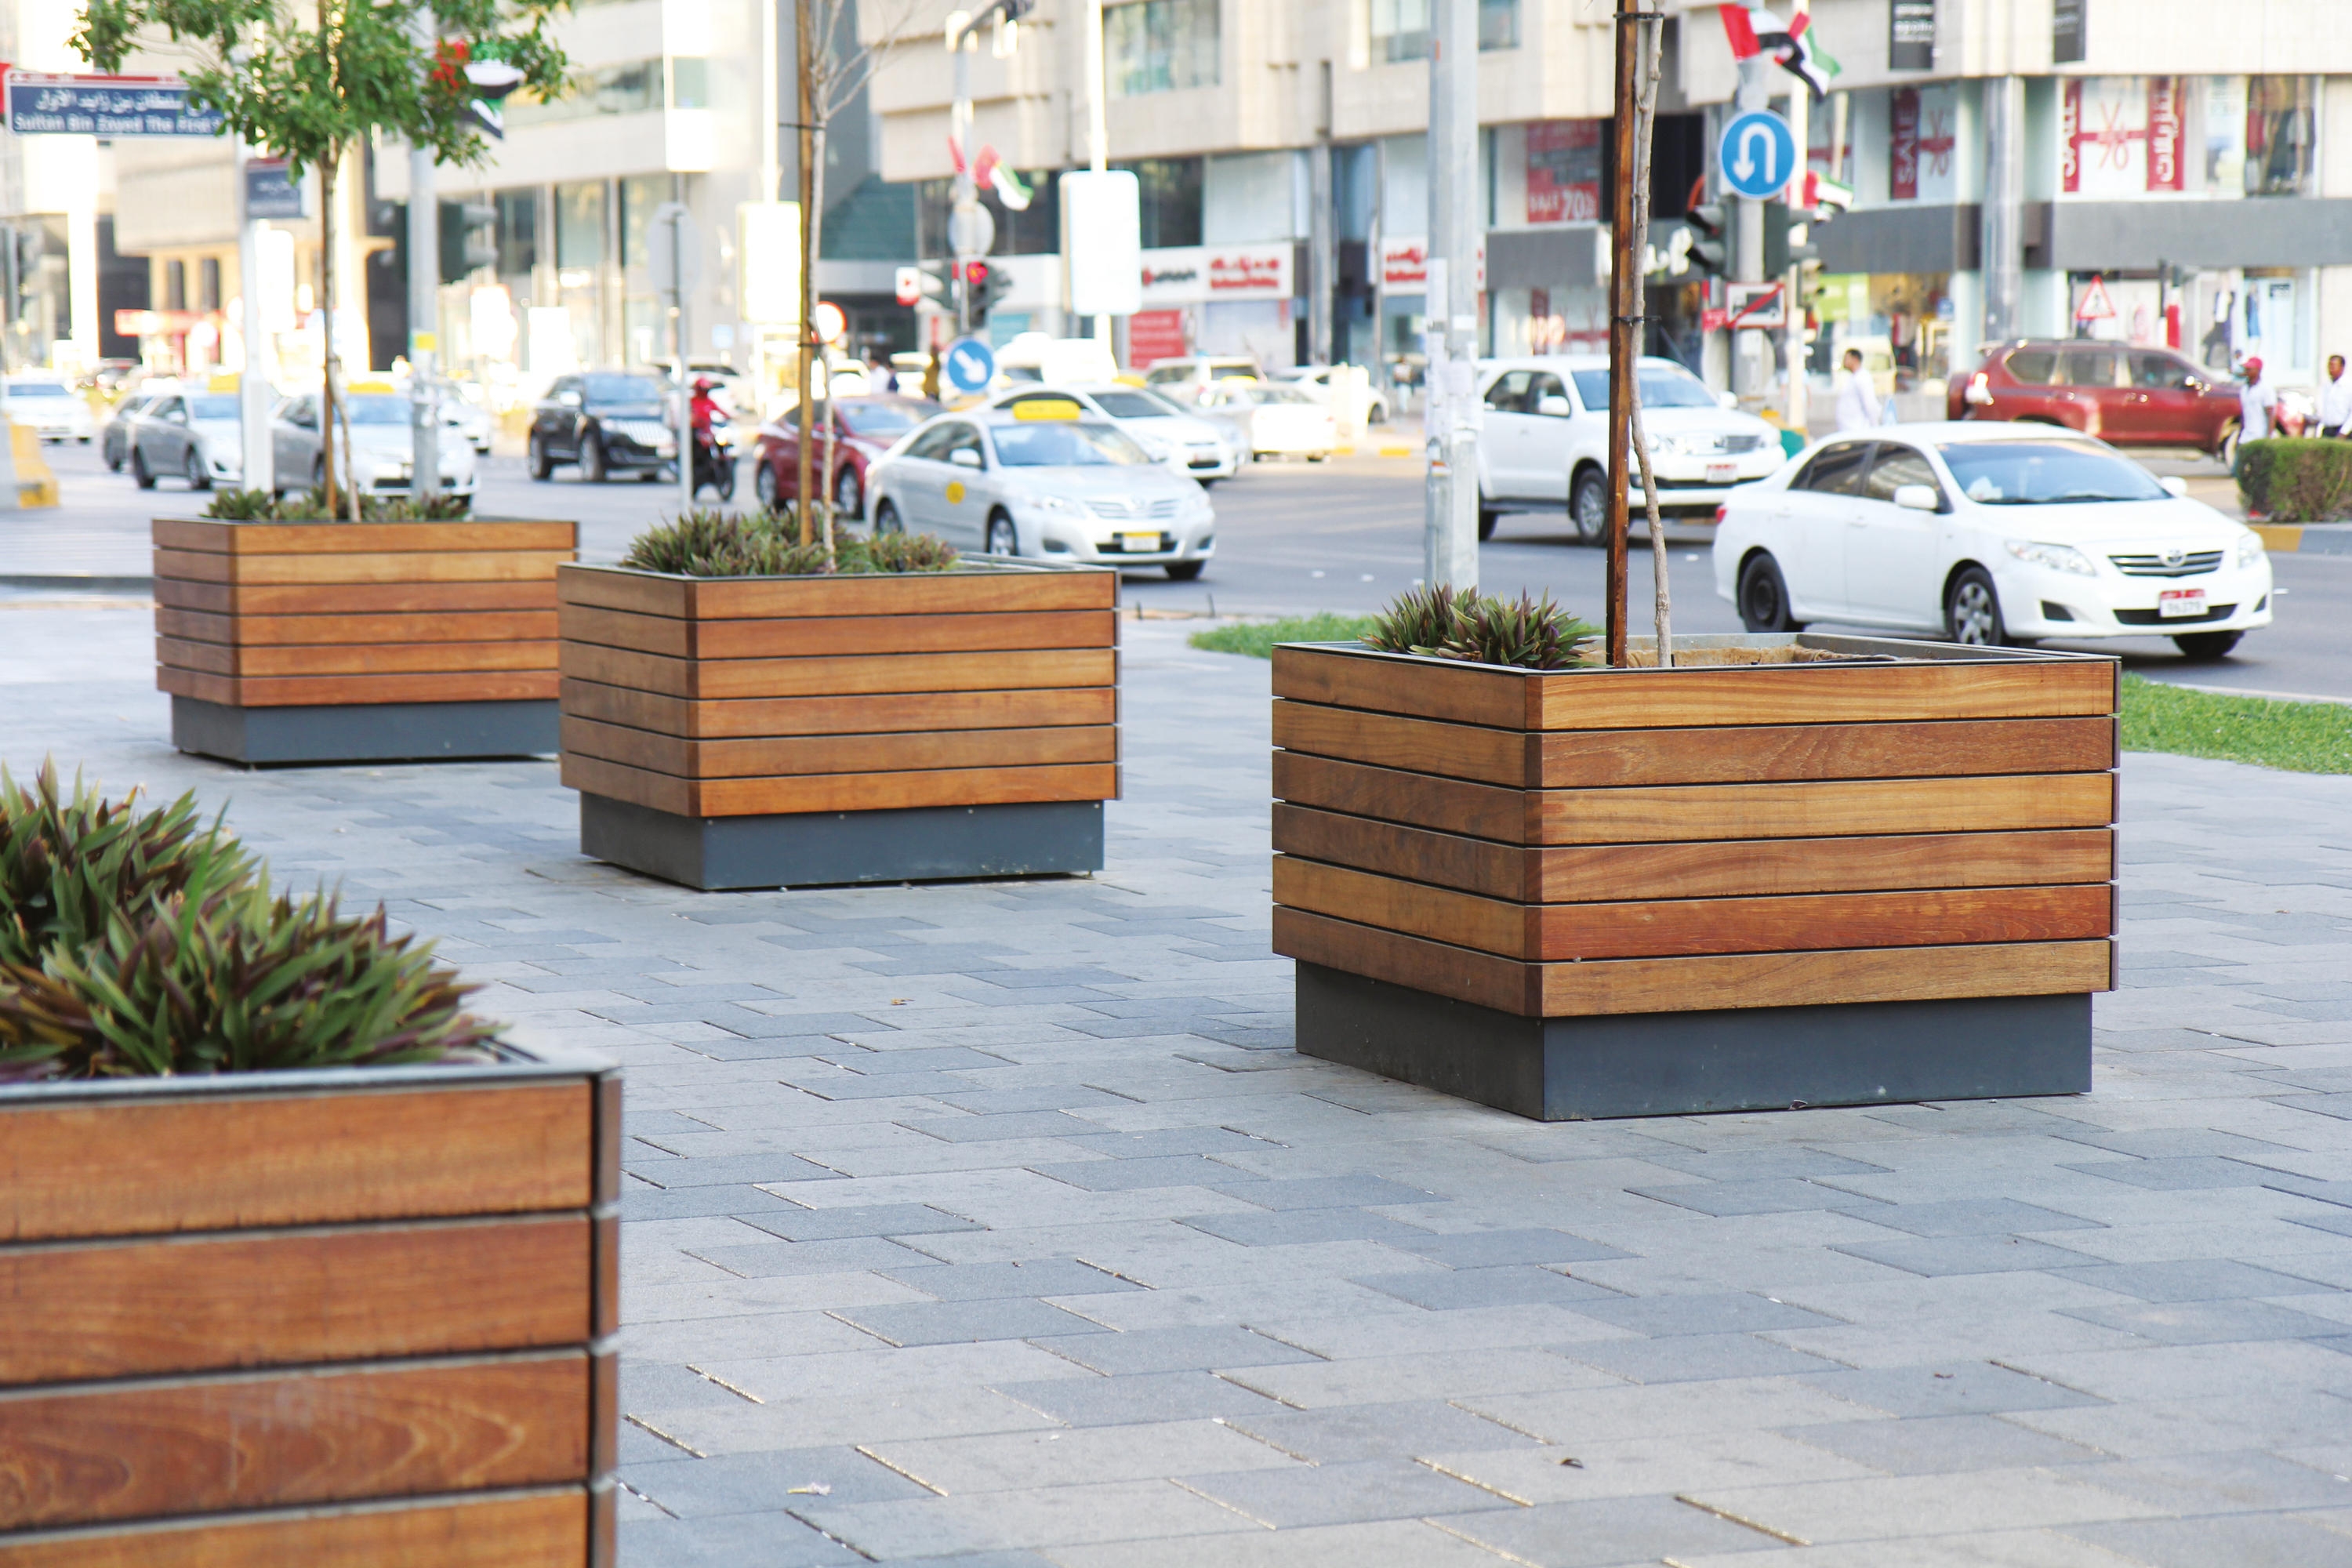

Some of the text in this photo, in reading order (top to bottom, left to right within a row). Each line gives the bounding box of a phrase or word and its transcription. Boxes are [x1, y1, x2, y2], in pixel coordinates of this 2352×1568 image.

[14, 113, 66, 132] Sultan
[67, 114, 95, 132] Bin
[145, 115, 175, 132] The
[1896, 109, 1915, 184] SALE
